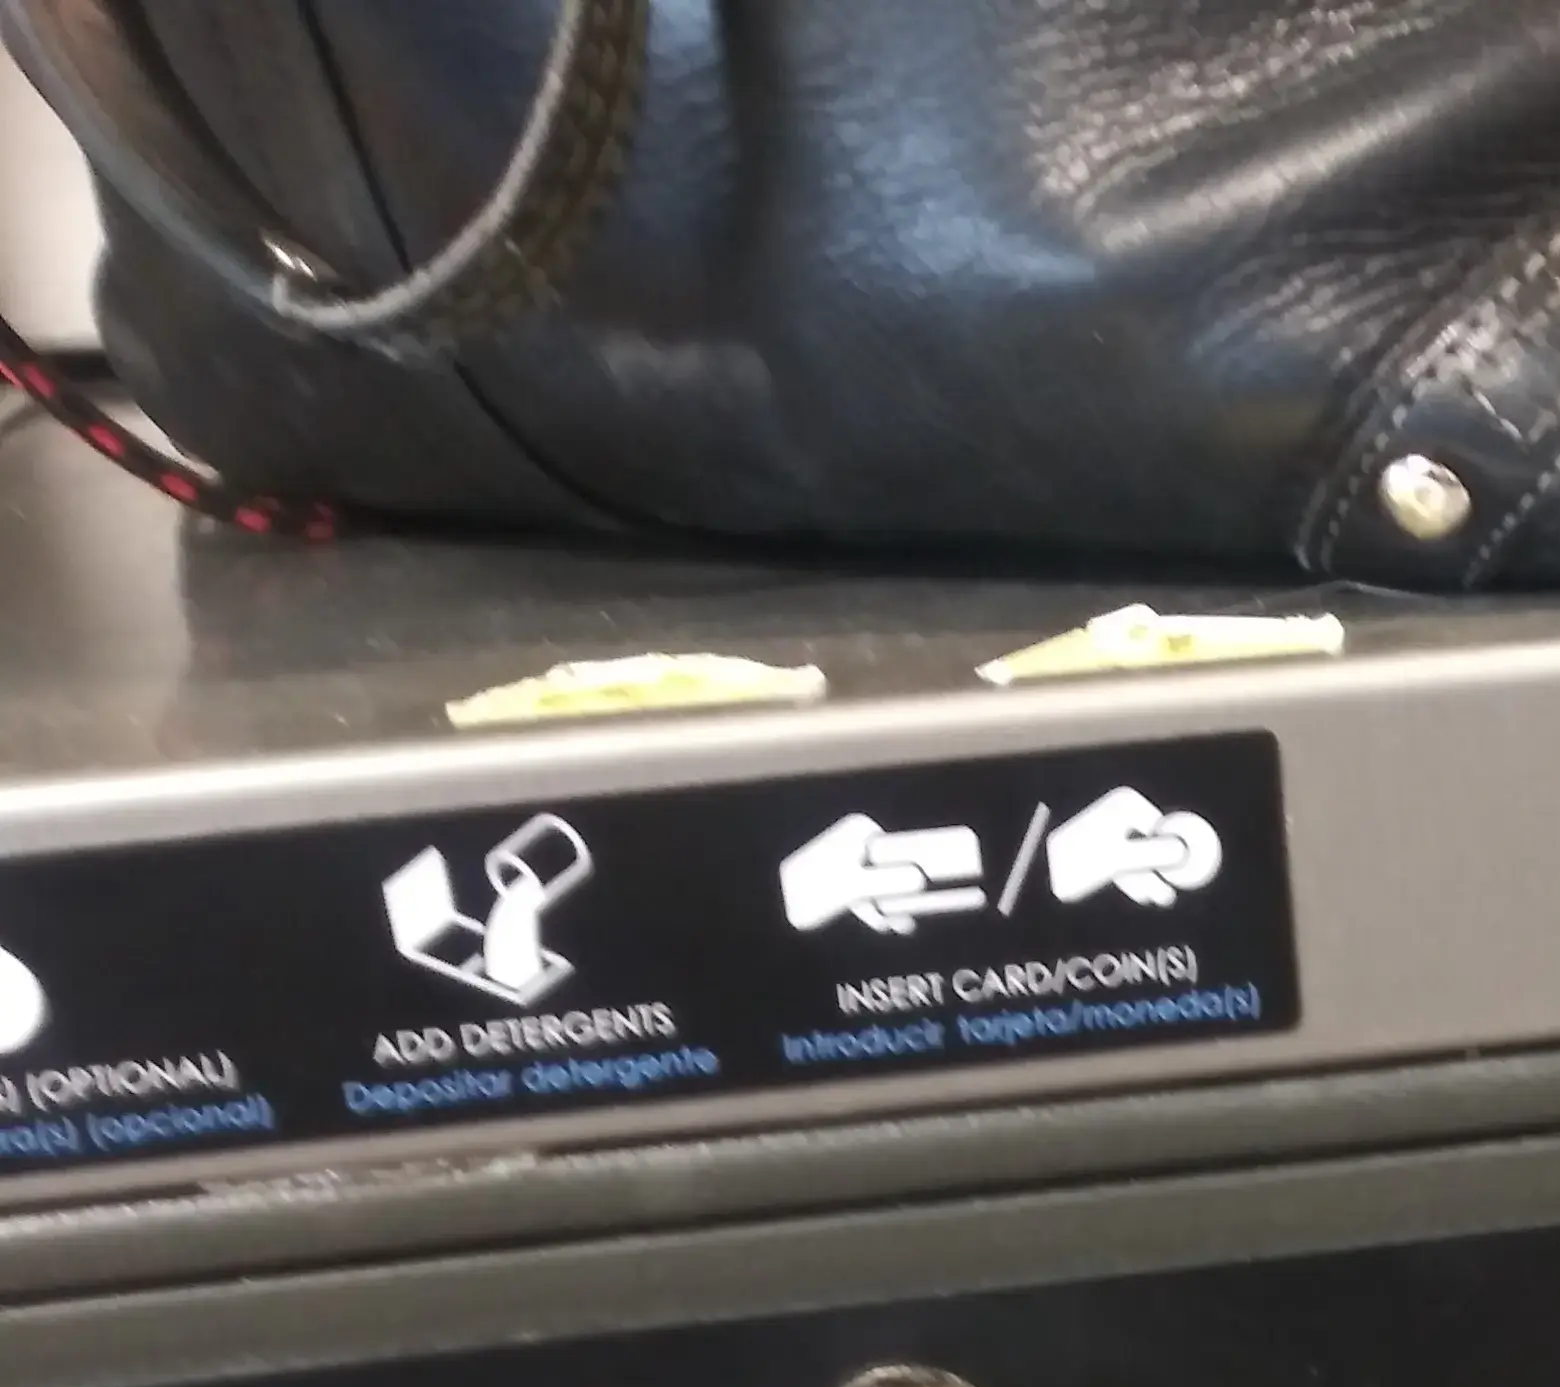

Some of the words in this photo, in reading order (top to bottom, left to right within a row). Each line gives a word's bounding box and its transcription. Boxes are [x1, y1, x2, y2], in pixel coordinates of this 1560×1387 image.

[836, 972, 945, 1015] INSERT
[952, 944, 1199, 1003] CARD/COIN(S)
[373, 1026, 457, 1068] ADD
[459, 1001, 679, 1058] DETERGENTS
[26, 1049, 241, 1111] (OPTIONAL)
